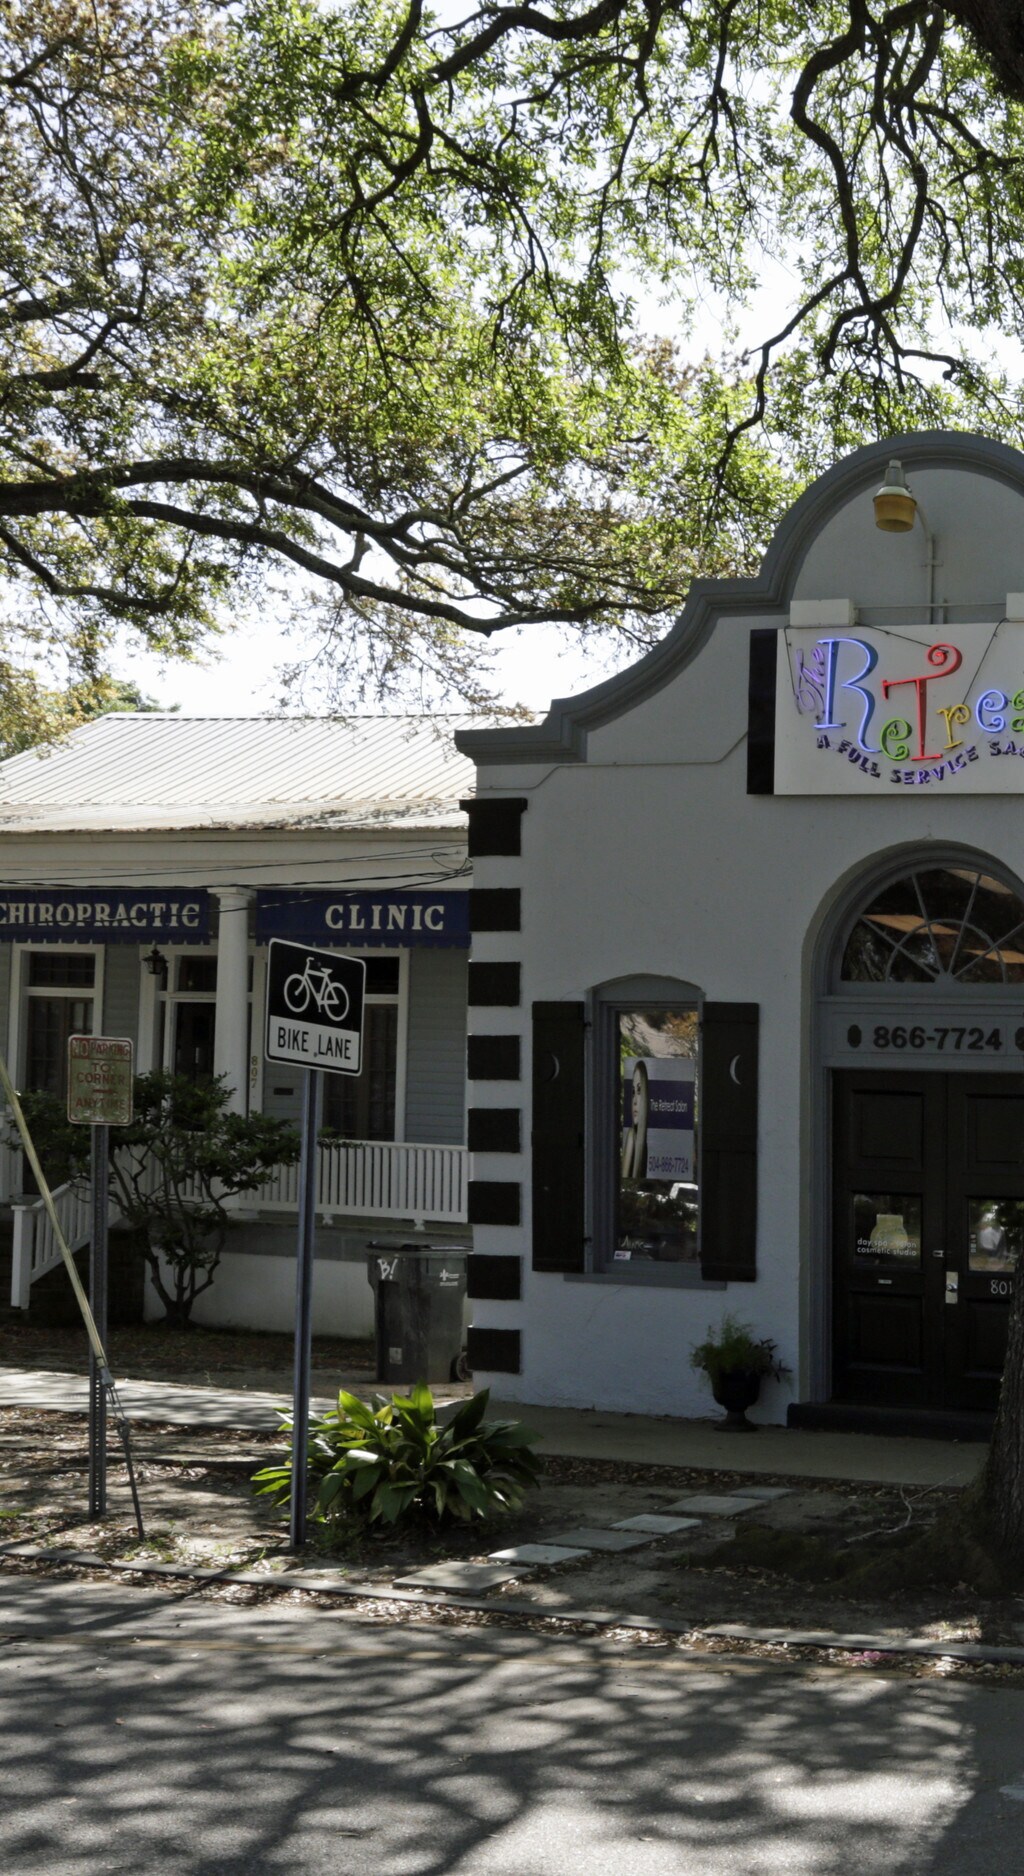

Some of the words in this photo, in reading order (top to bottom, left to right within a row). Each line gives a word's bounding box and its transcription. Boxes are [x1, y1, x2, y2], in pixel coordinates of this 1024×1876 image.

[816, 734, 831, 750] A
[837, 738, 882, 779] FULL
[890, 745, 979, 785] SERVICE
[325, 904, 446, 931] CLINIC
[277, 1026, 309, 1053] BIKE
[318, 1033, 352, 1060] LANE
[873, 1026, 1003, 1051] 866-7724
[72, 1040, 88, 1057] NO
[90, 1040, 131, 1058] PARKING
[91, 1062, 111, 1073] TO
[76, 1072, 125, 1085] CORNER
[75, 1097, 126, 1110] ANYTIME
[857, 1237, 872, 1247] day
[875, 1240, 888, 1248] spa
[856, 1246, 890, 1255] cosmetic
[893, 1247, 917, 1256] studio
[990, 1279, 1013, 1295] 801
